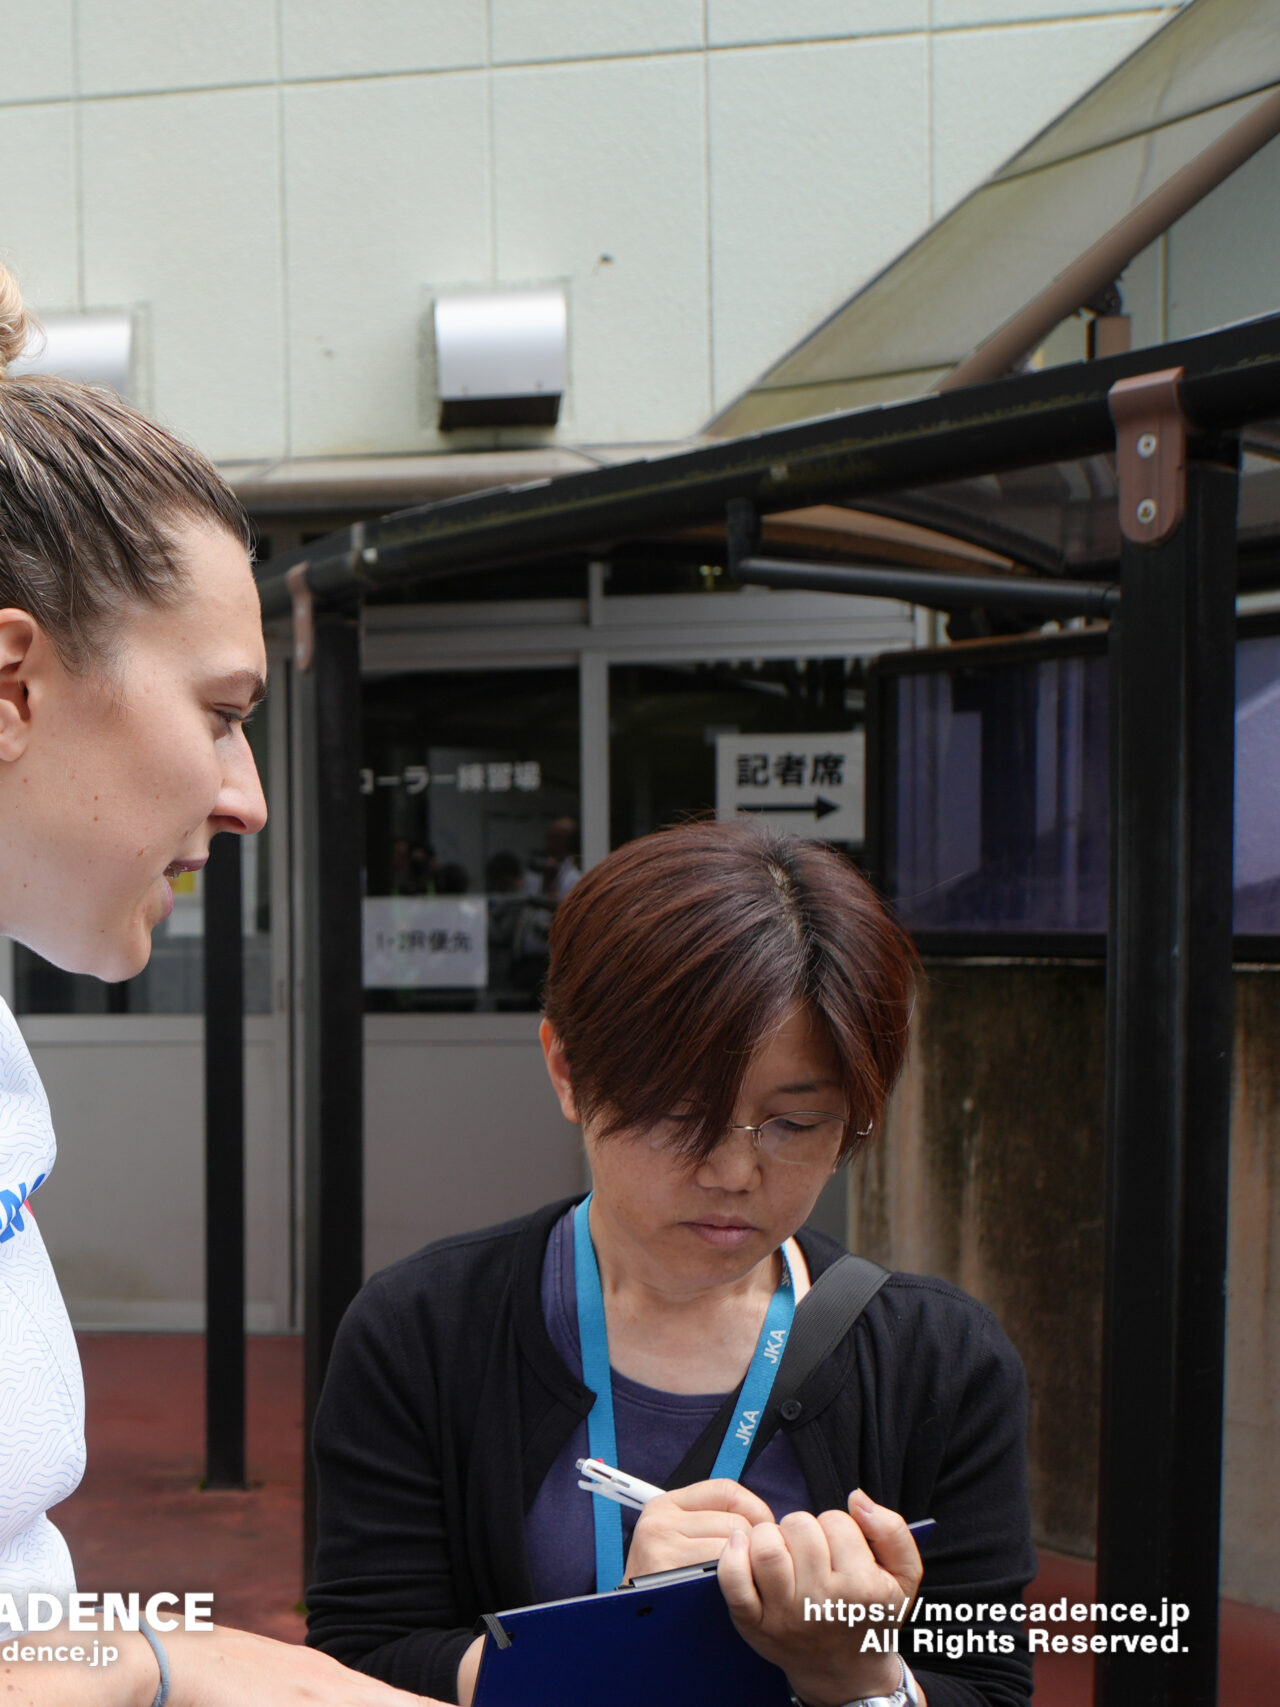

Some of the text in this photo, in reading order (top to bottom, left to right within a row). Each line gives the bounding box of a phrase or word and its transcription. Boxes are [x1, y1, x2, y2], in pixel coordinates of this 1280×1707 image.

[736, 752, 846, 788] 記者席
[764, 1329, 786, 1364] JKA
[735, 1410, 760, 1446] JKA
